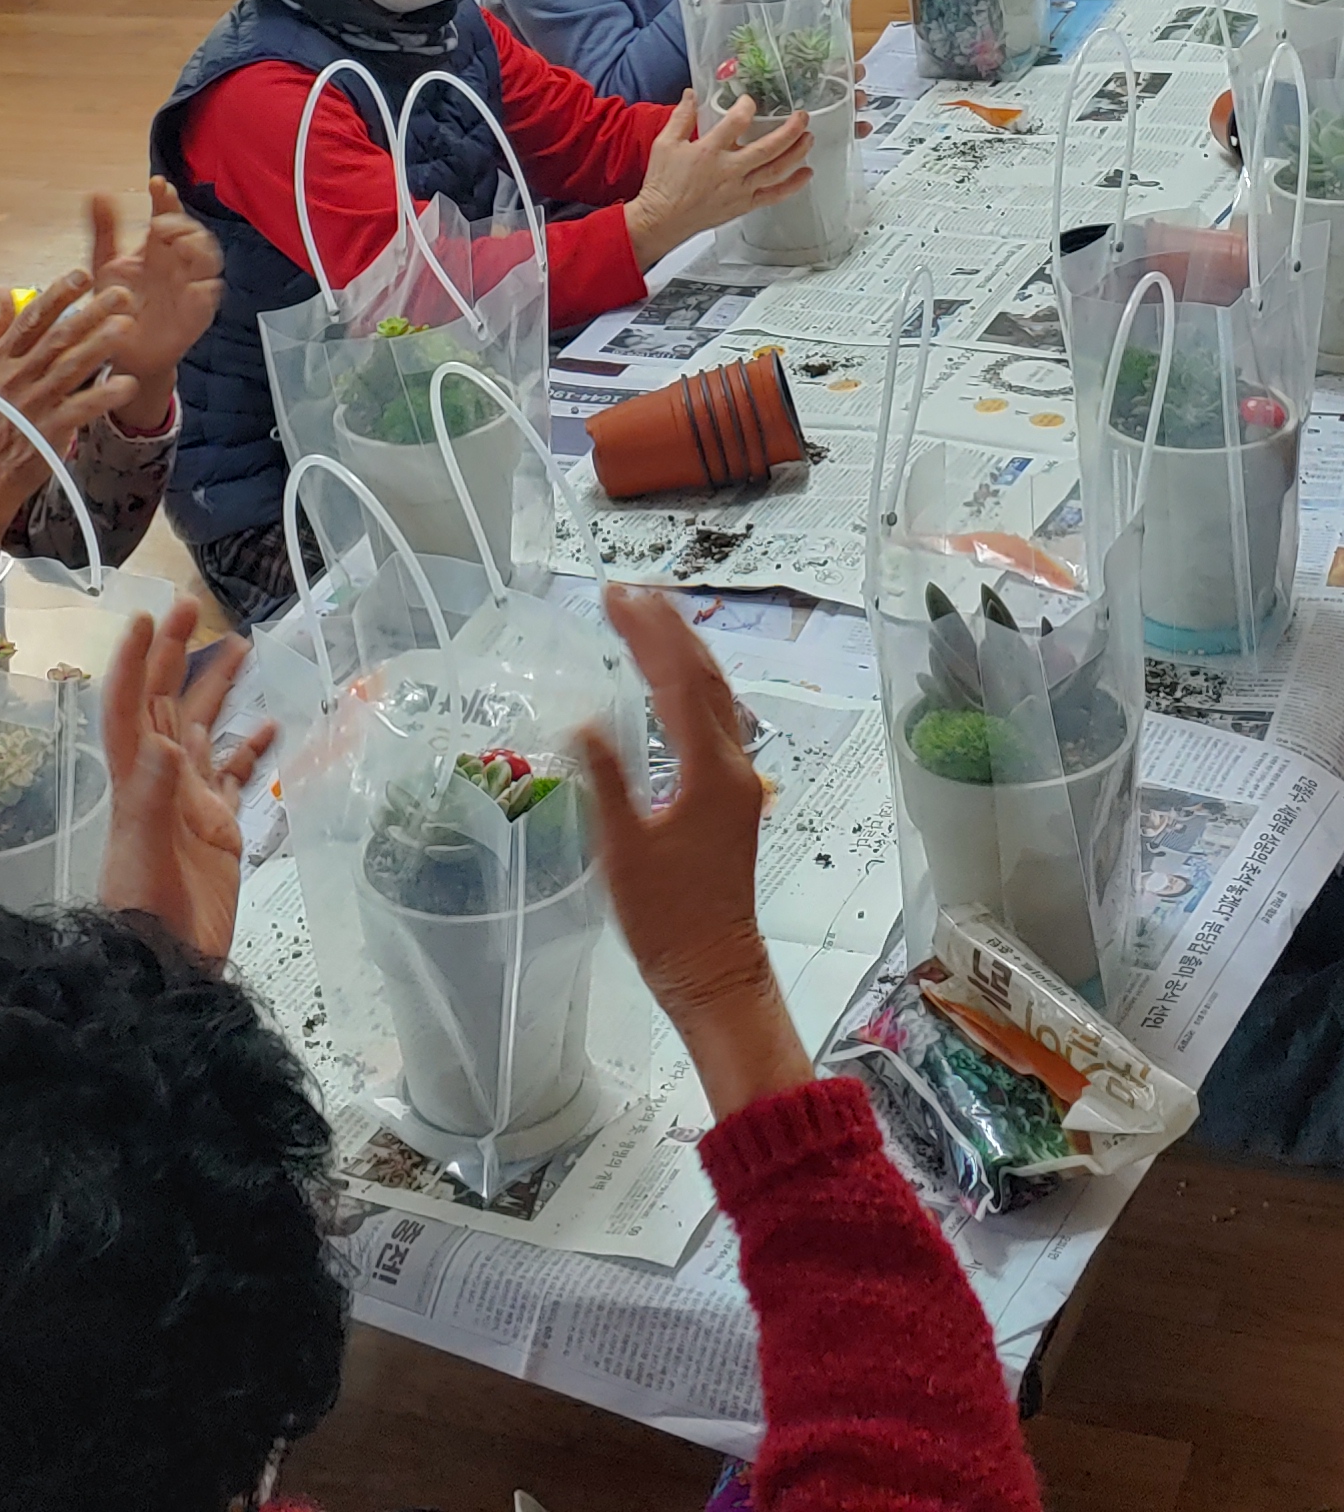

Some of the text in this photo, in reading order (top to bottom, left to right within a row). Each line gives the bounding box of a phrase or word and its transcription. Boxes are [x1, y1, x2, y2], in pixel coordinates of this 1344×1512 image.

[1288, 775, 1317, 804] 안철수
[1246, 833, 1281, 865] 성공의
[1233, 864, 1260, 887] 초석
[1188, 920, 1224, 955] 분당갑
[1172, 954, 1202, 979] 출마
[1156, 979, 1186, 1004] 공식
